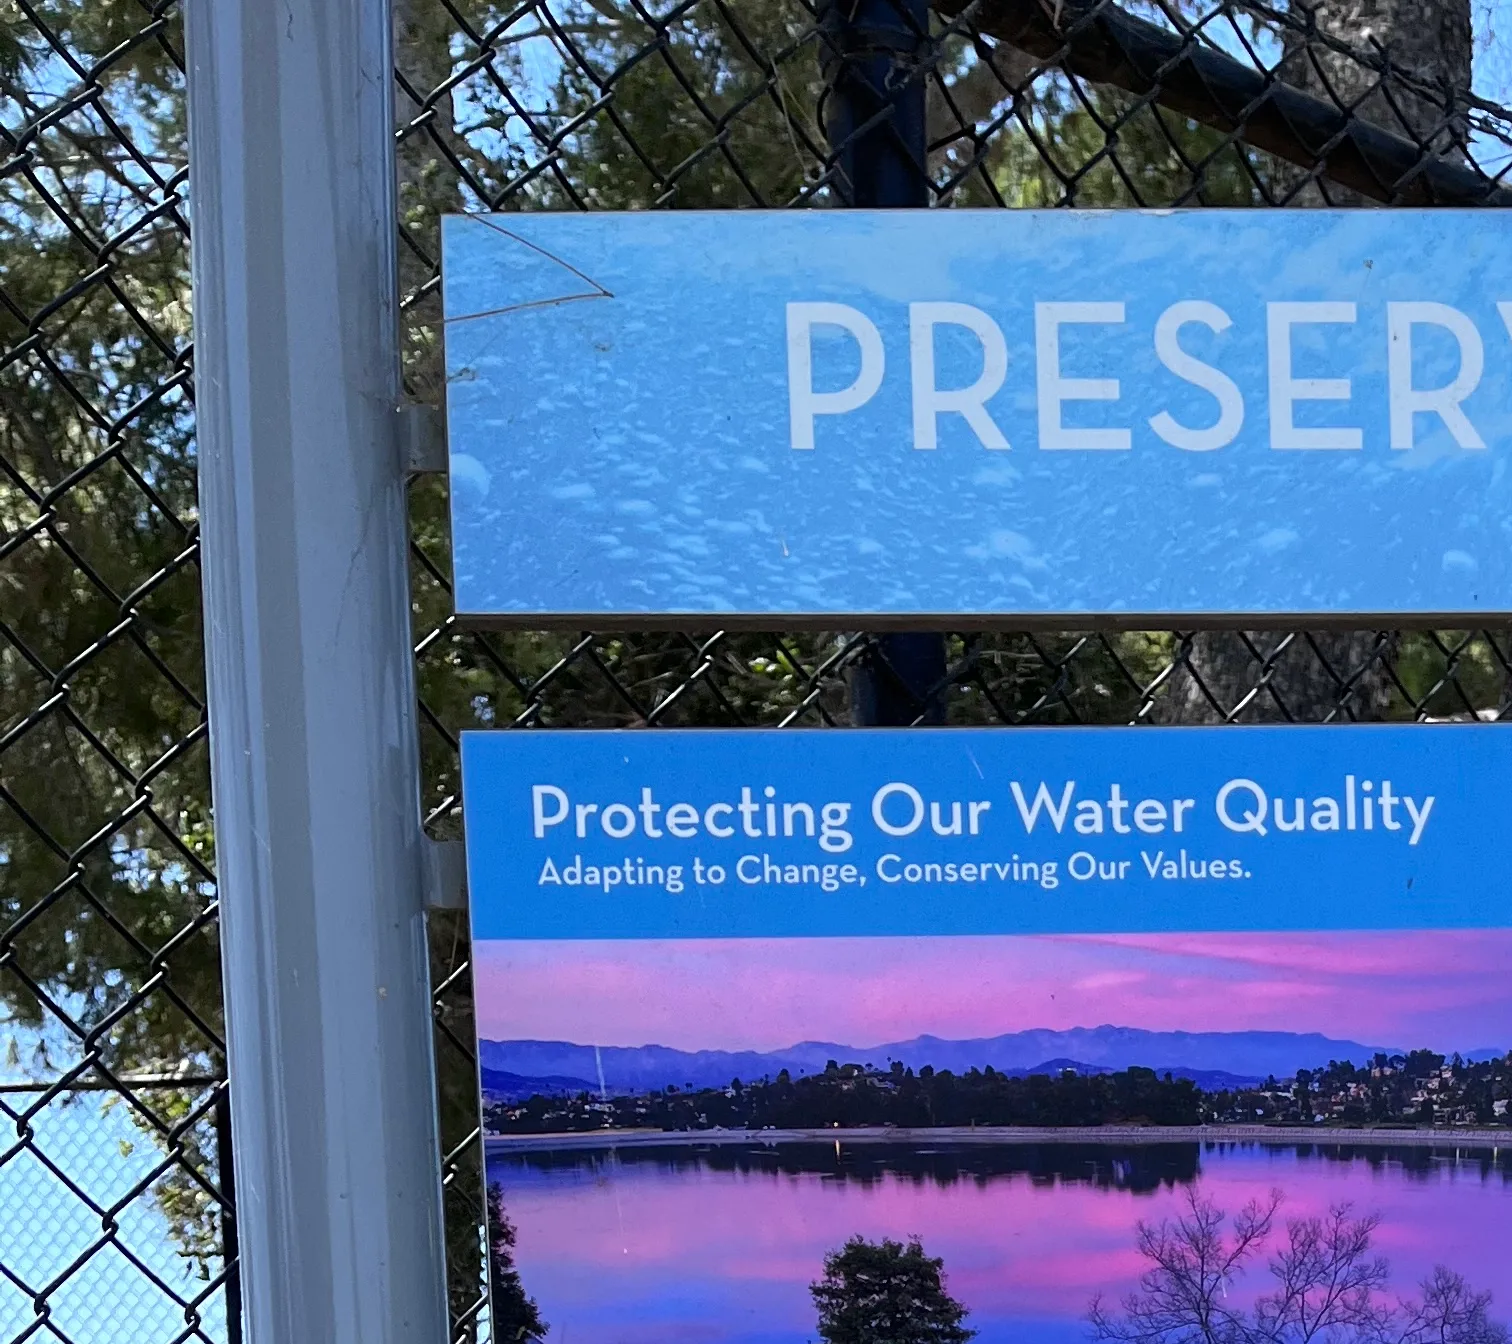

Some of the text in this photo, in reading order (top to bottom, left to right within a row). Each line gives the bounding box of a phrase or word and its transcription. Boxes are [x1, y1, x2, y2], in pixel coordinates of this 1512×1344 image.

[531, 774, 1435, 853] Protecting Our Water Quality
[538, 849, 1252, 894] Adapting to Change, Conserving Our Values.
